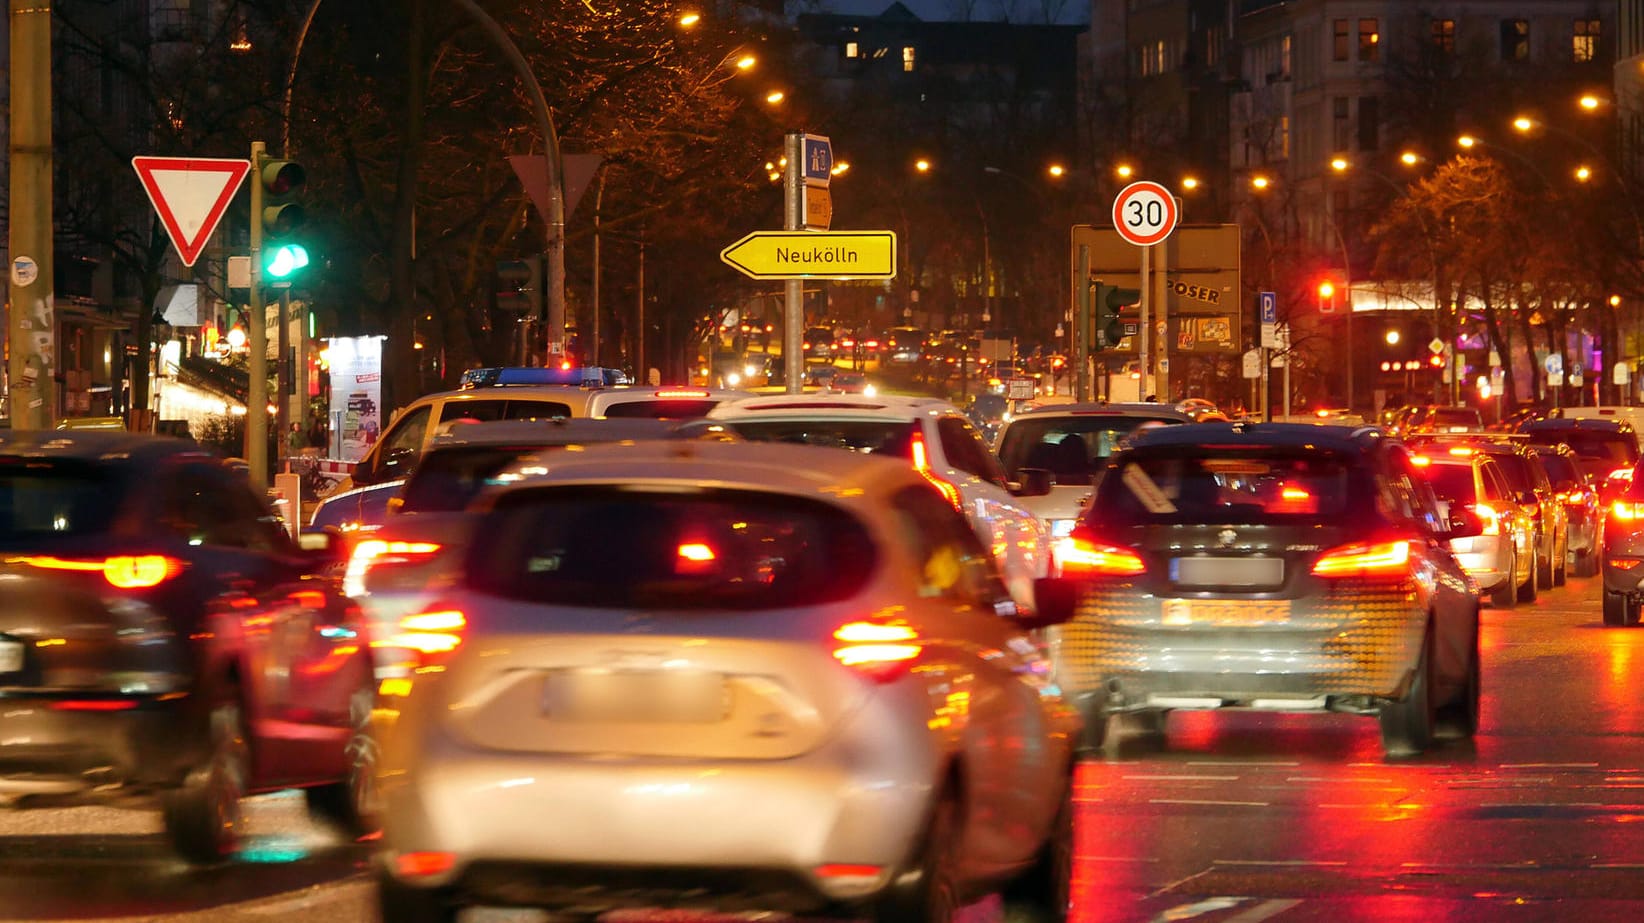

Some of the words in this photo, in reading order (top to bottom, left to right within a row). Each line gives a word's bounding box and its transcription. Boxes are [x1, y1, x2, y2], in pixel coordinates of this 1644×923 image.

[1128, 201, 1162, 227] 30
[777, 247, 858, 263] Neukölln
[1264, 296, 1273, 320] P
